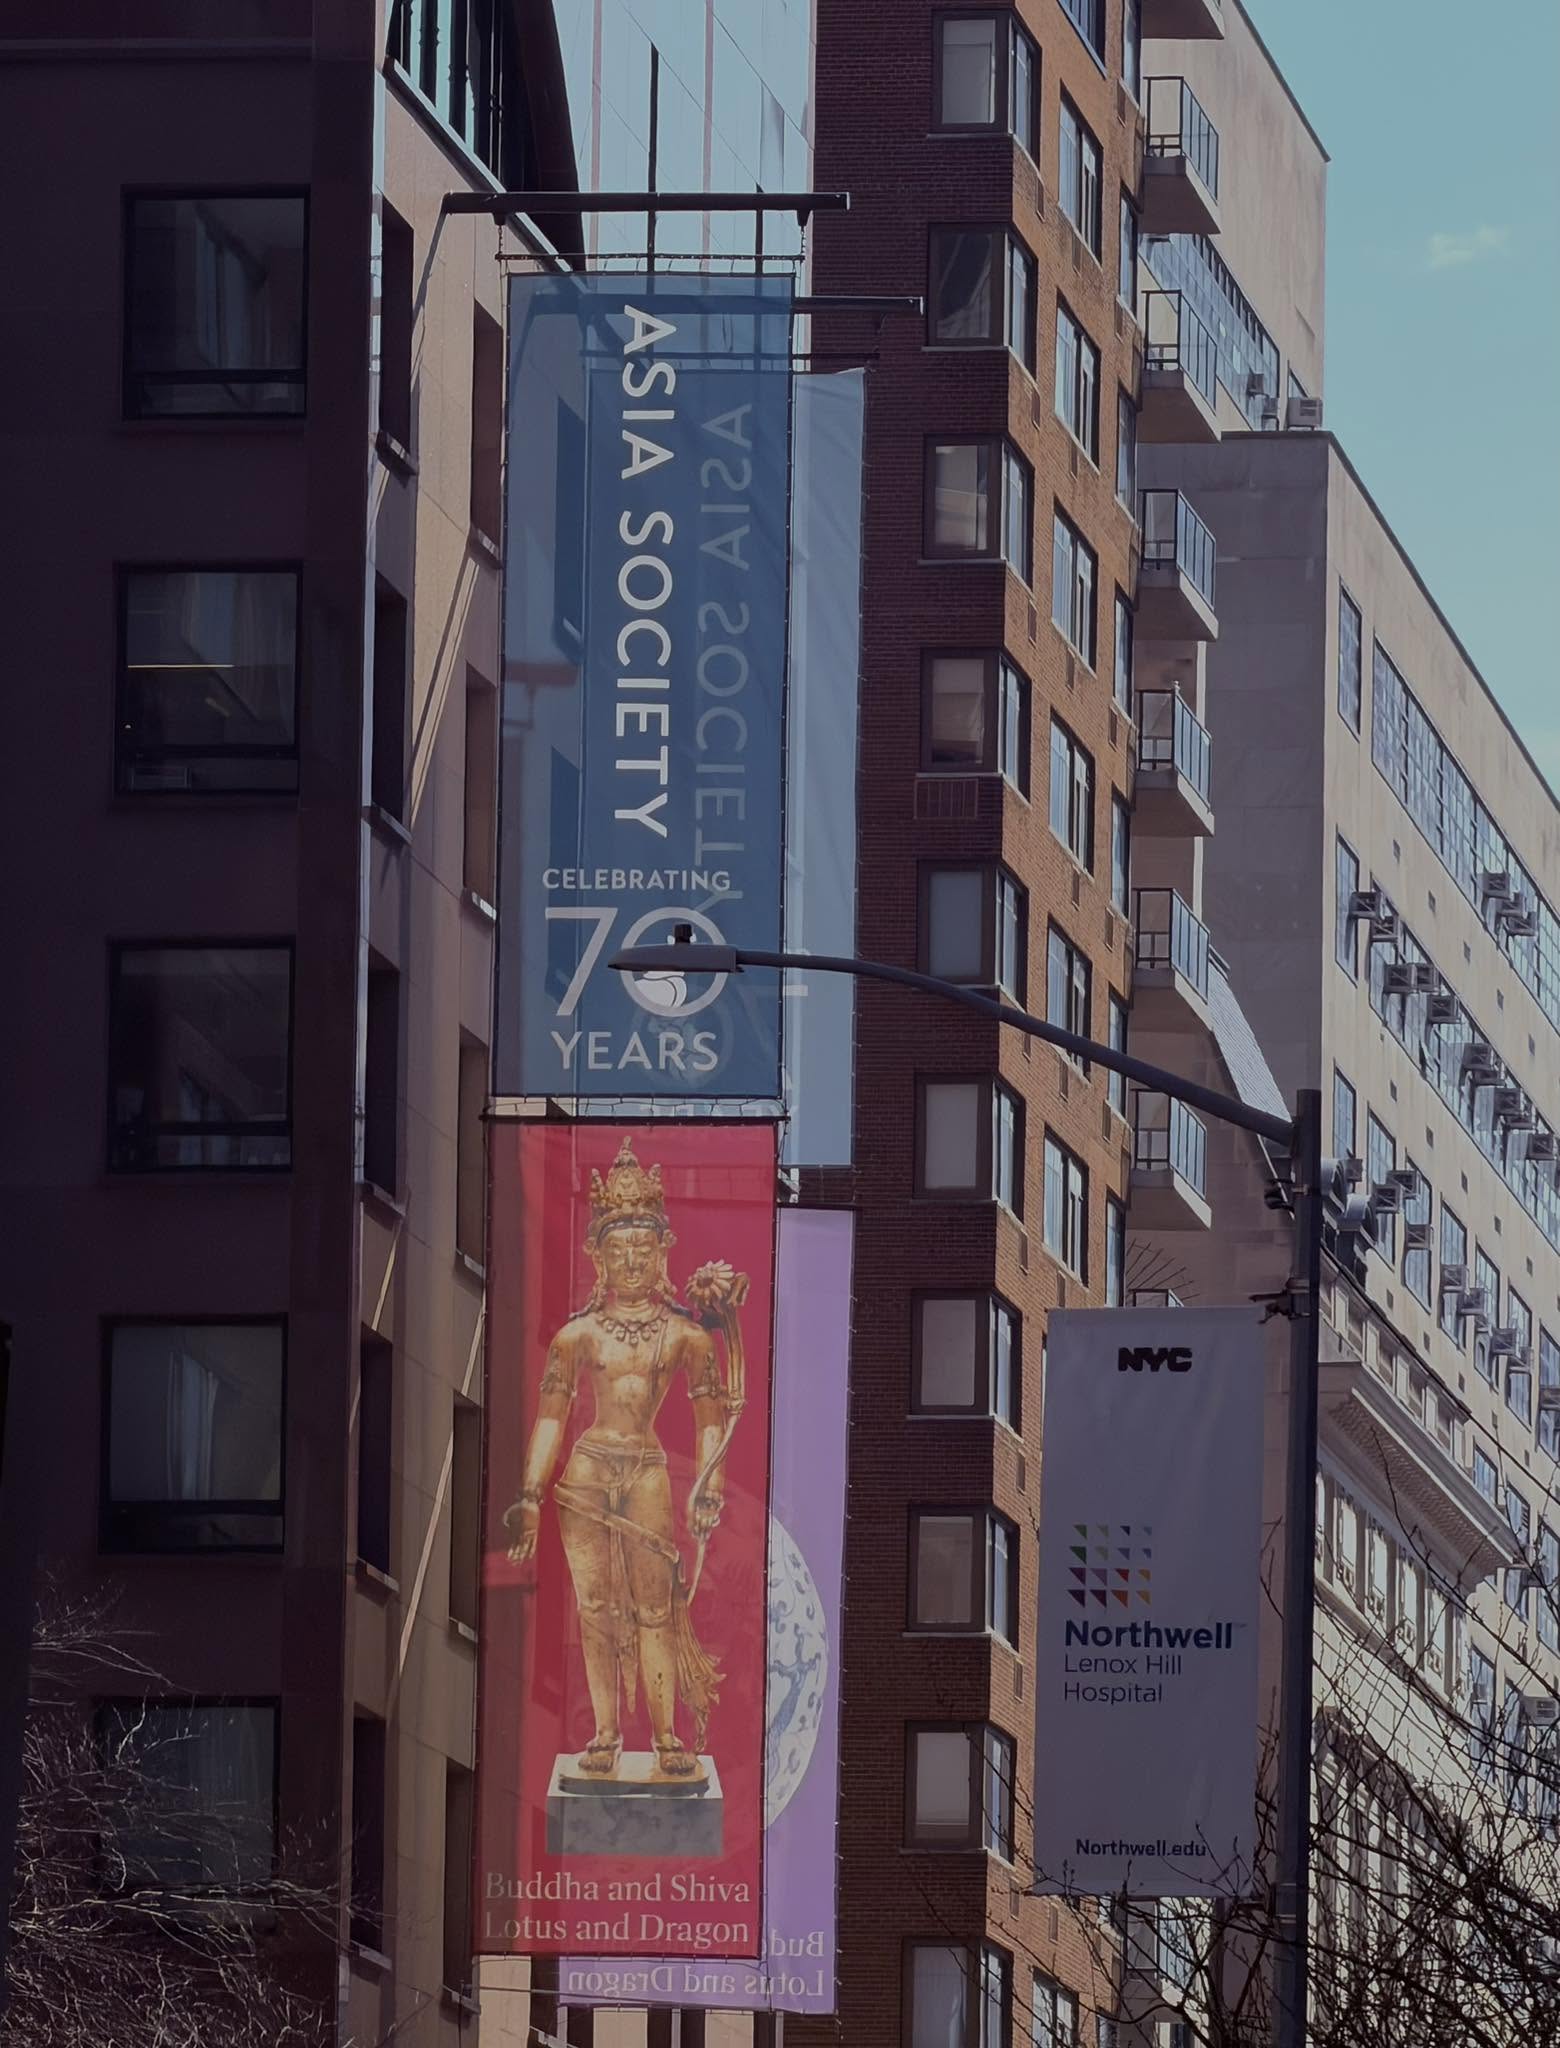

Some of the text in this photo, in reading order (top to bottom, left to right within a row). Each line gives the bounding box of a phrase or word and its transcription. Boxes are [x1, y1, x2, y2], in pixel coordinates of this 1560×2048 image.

[614, 304, 677, 838] ASIA SOCIETY
[541, 868, 731, 892] CELEBRATING
[545, 906, 729, 1018] 70
[550, 1031, 719, 1072] YEARS
[1117, 1347, 1193, 1372] NYC
[1064, 1619, 1233, 1649] Northwell
[1063, 1653, 1182, 1676] Lenox Hill
[1063, 1681, 1163, 1705] Hospital
[1075, 1839, 1207, 1857] Northwell.edu
[484, 1871, 751, 1903] Buddha and Shiva
[484, 1912, 750, 1949] Lotus and Dragon
